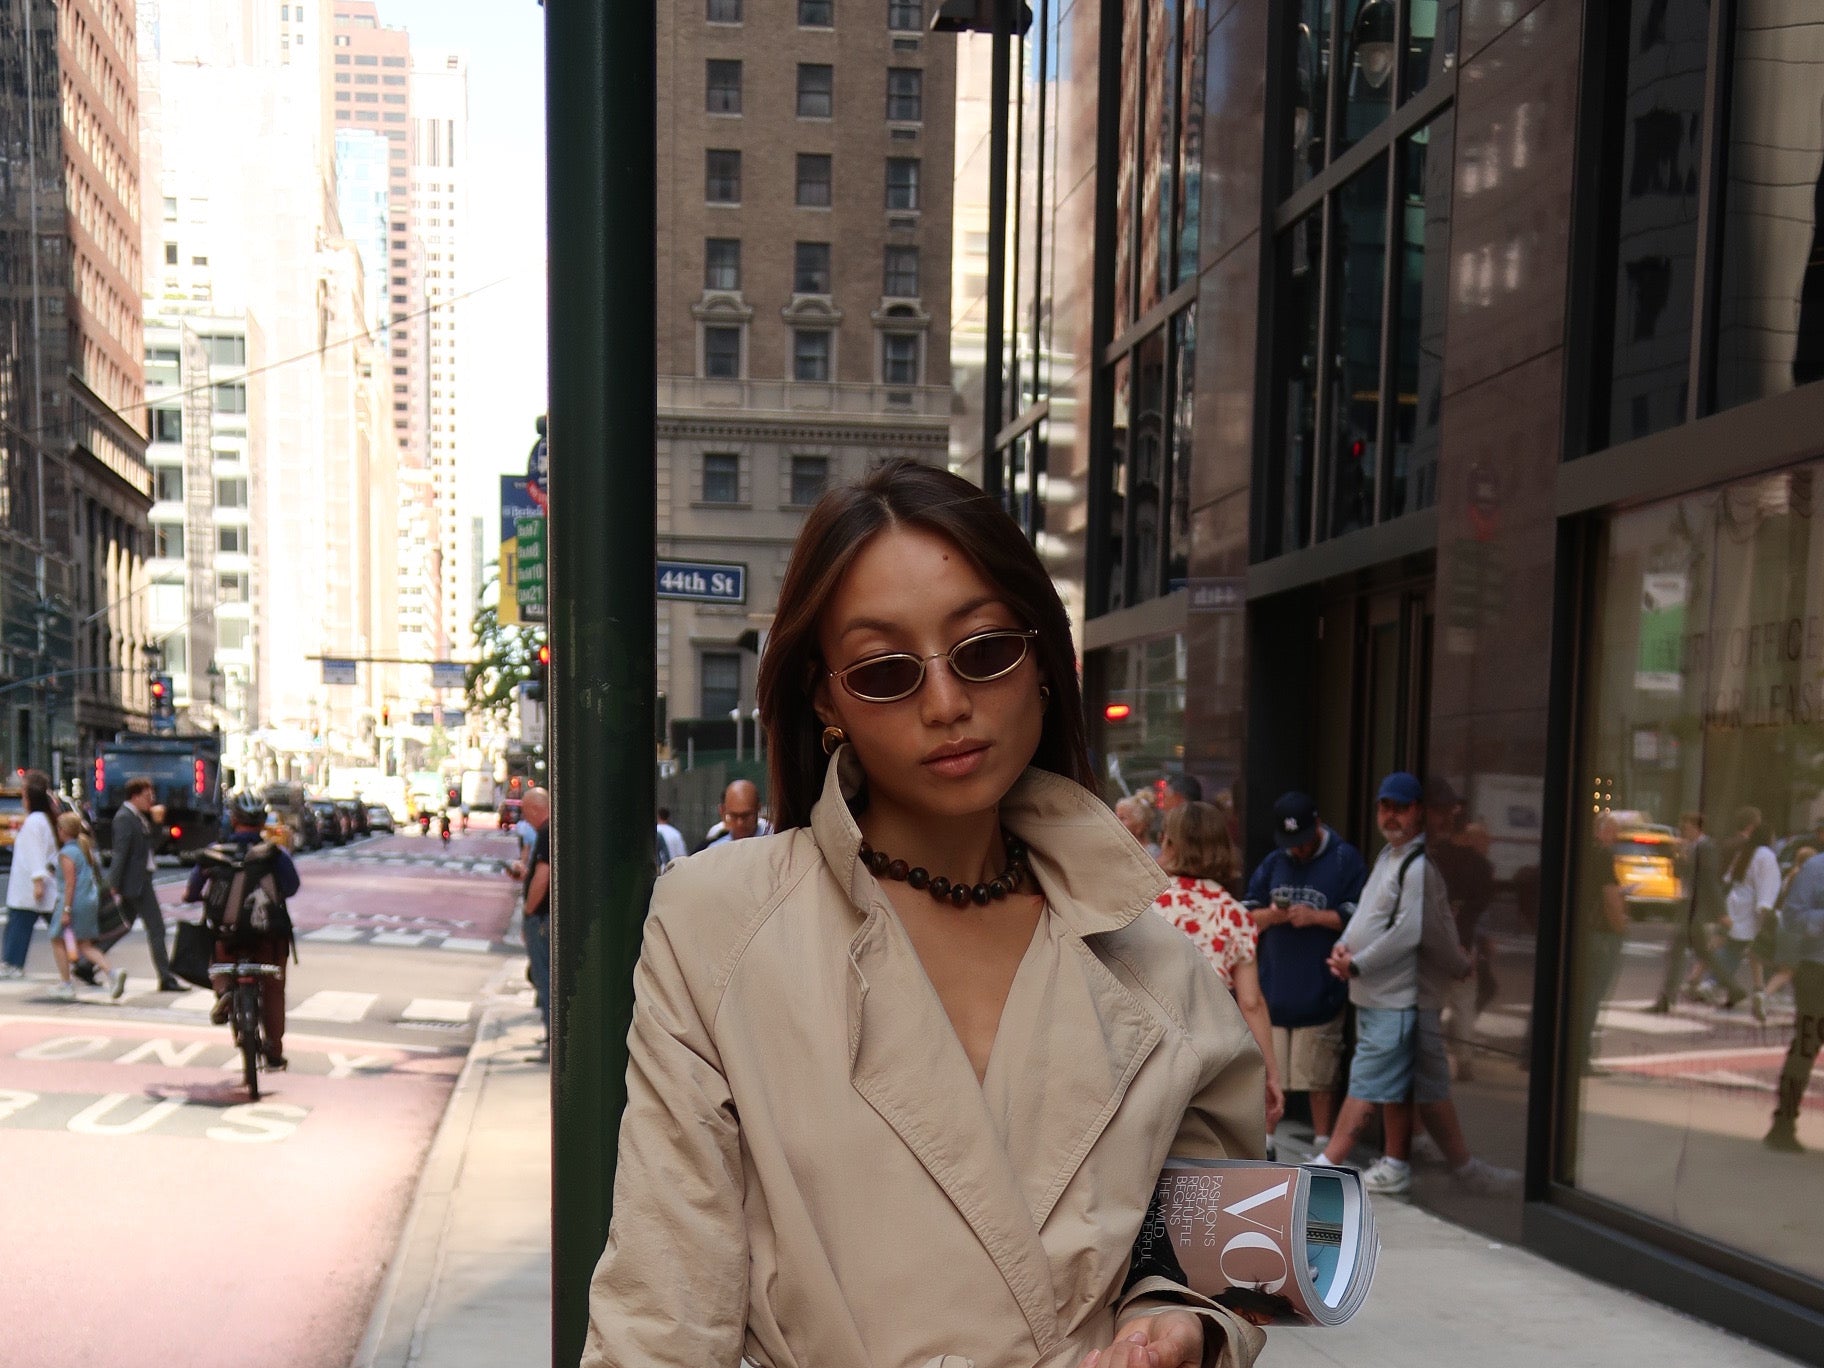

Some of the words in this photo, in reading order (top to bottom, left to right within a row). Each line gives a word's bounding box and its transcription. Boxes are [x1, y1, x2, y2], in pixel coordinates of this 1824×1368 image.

[660, 570, 707, 593] 44th
[711, 572, 734, 595] St
[1158, 1176, 1173, 1200] THE
[1170, 1176, 1188, 1226] BEGINS
[1180, 1175, 1200, 1247] RESHUFFLE
[1194, 1175, 1211, 1222] GREAT
[1204, 1175, 1224, 1247] FASHION'S
